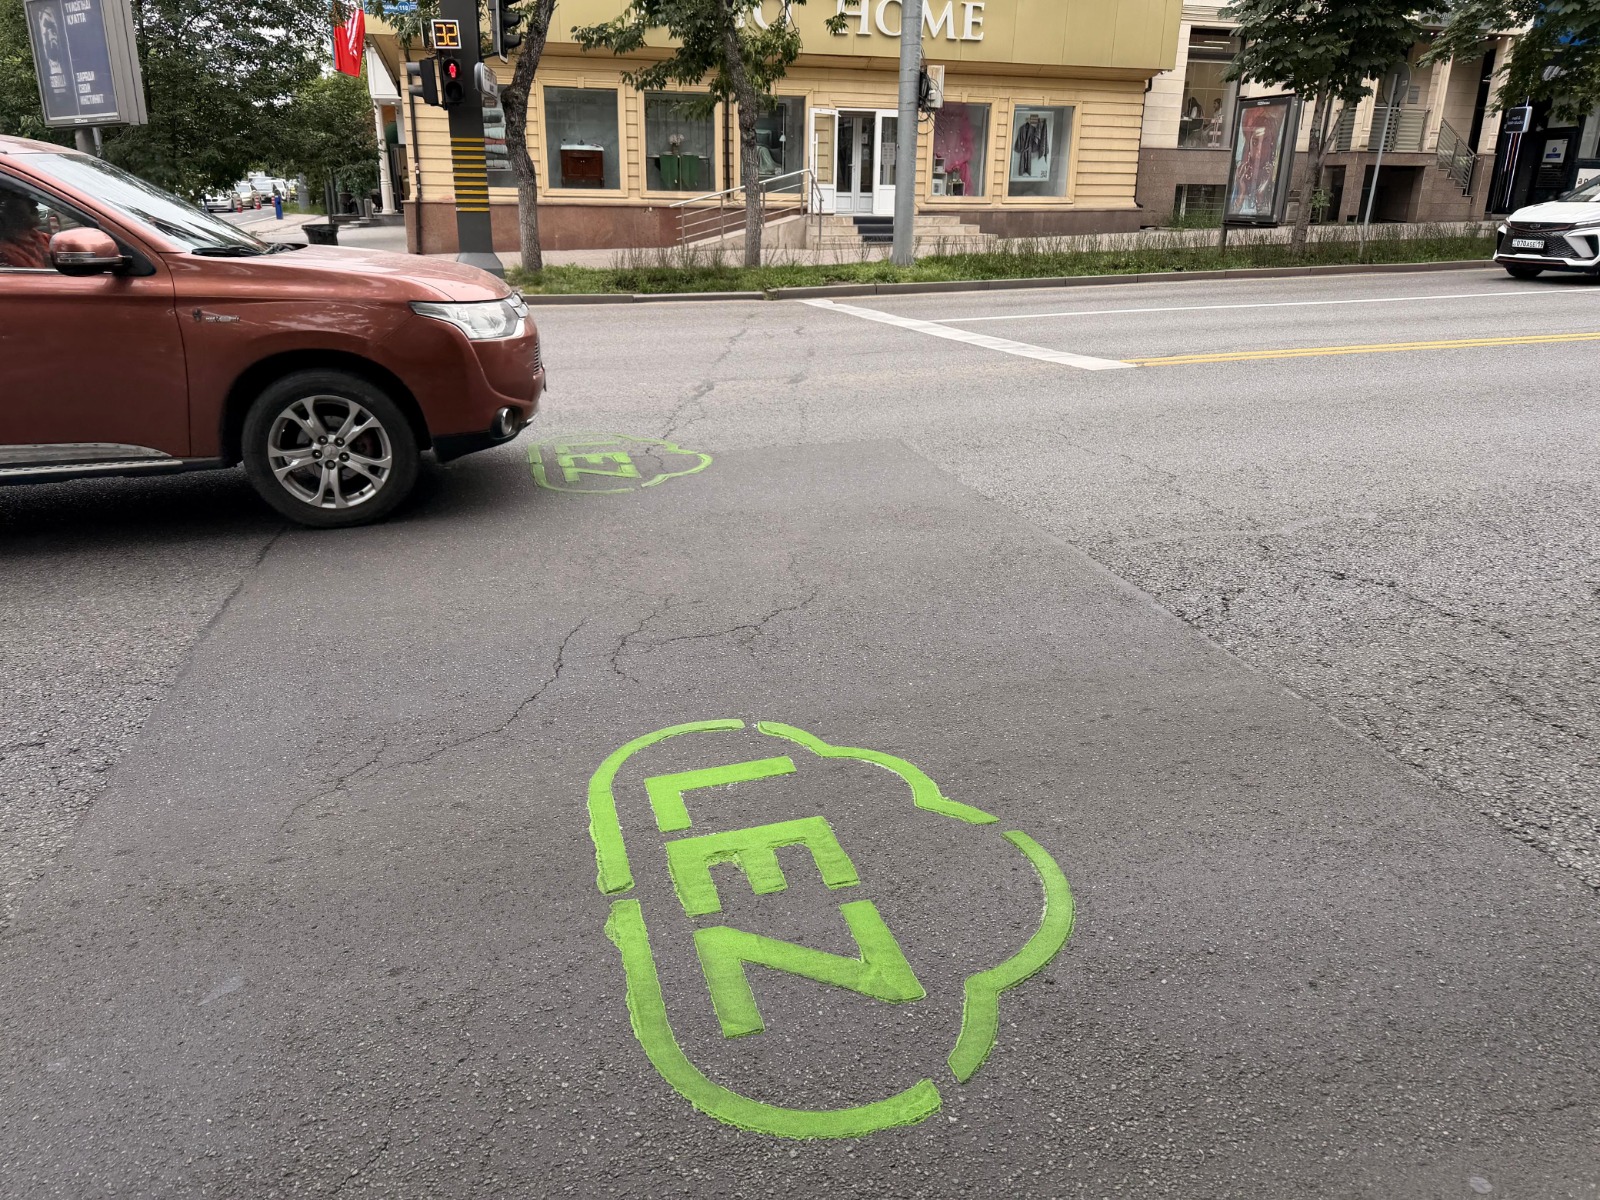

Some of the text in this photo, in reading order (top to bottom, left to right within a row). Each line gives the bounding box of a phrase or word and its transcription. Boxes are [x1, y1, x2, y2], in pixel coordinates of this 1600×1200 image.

[435, 24, 458, 46] 32
[834, 0, 985, 41] HOME
[554, 441, 642, 482] LEZ
[644, 756, 926, 1038] LEZ
